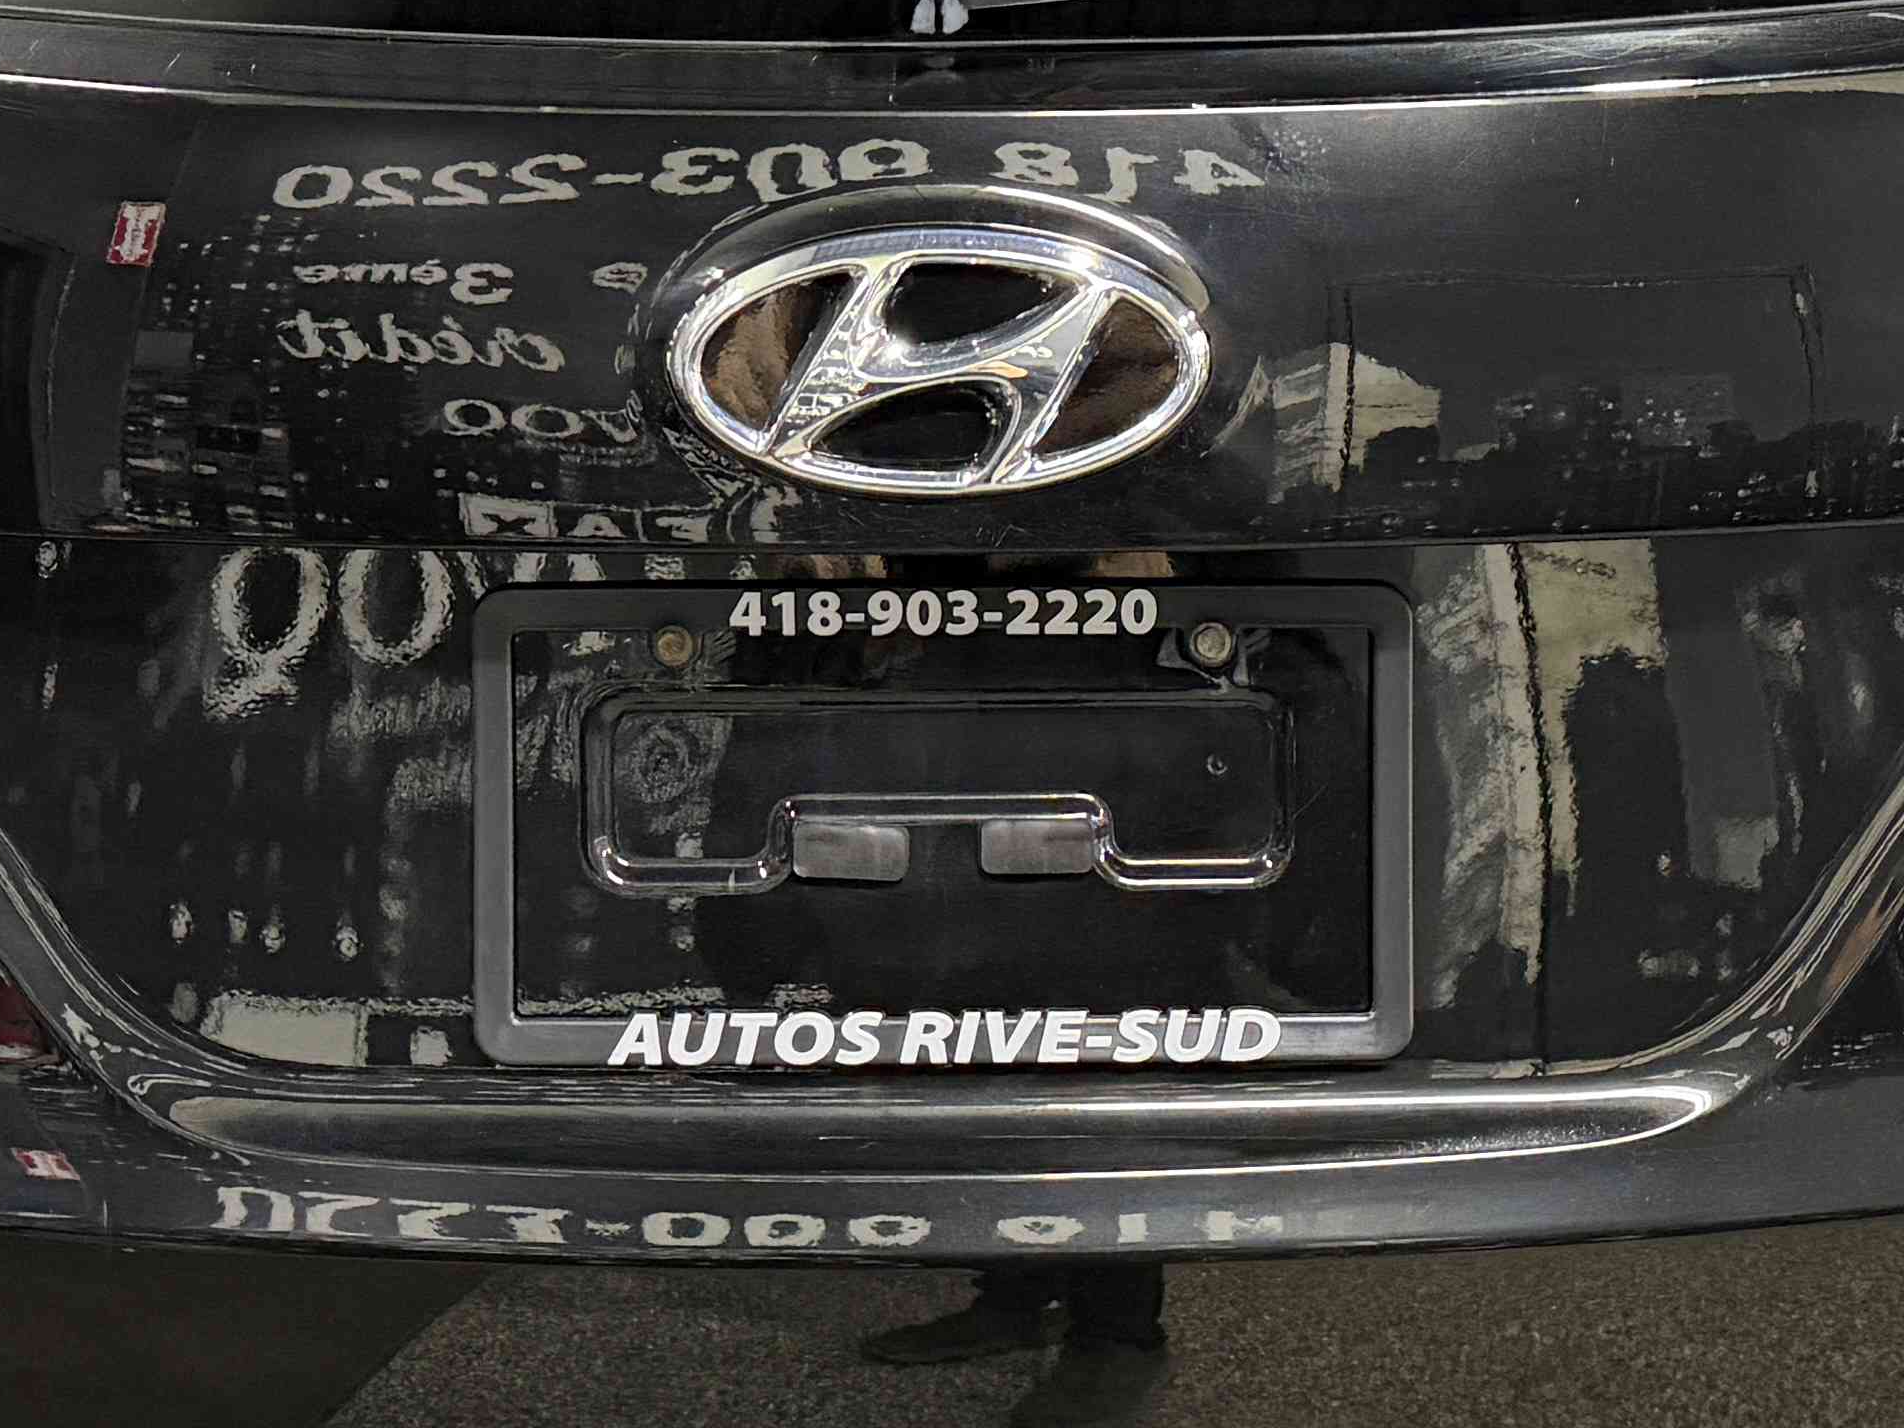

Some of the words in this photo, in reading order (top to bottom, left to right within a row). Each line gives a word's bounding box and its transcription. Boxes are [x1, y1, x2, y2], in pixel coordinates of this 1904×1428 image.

[729, 588, 1158, 637] 418-903-2220
[608, 1010, 884, 1066] AUTOS
[900, 1008, 1281, 1065] RIVE-SUD
